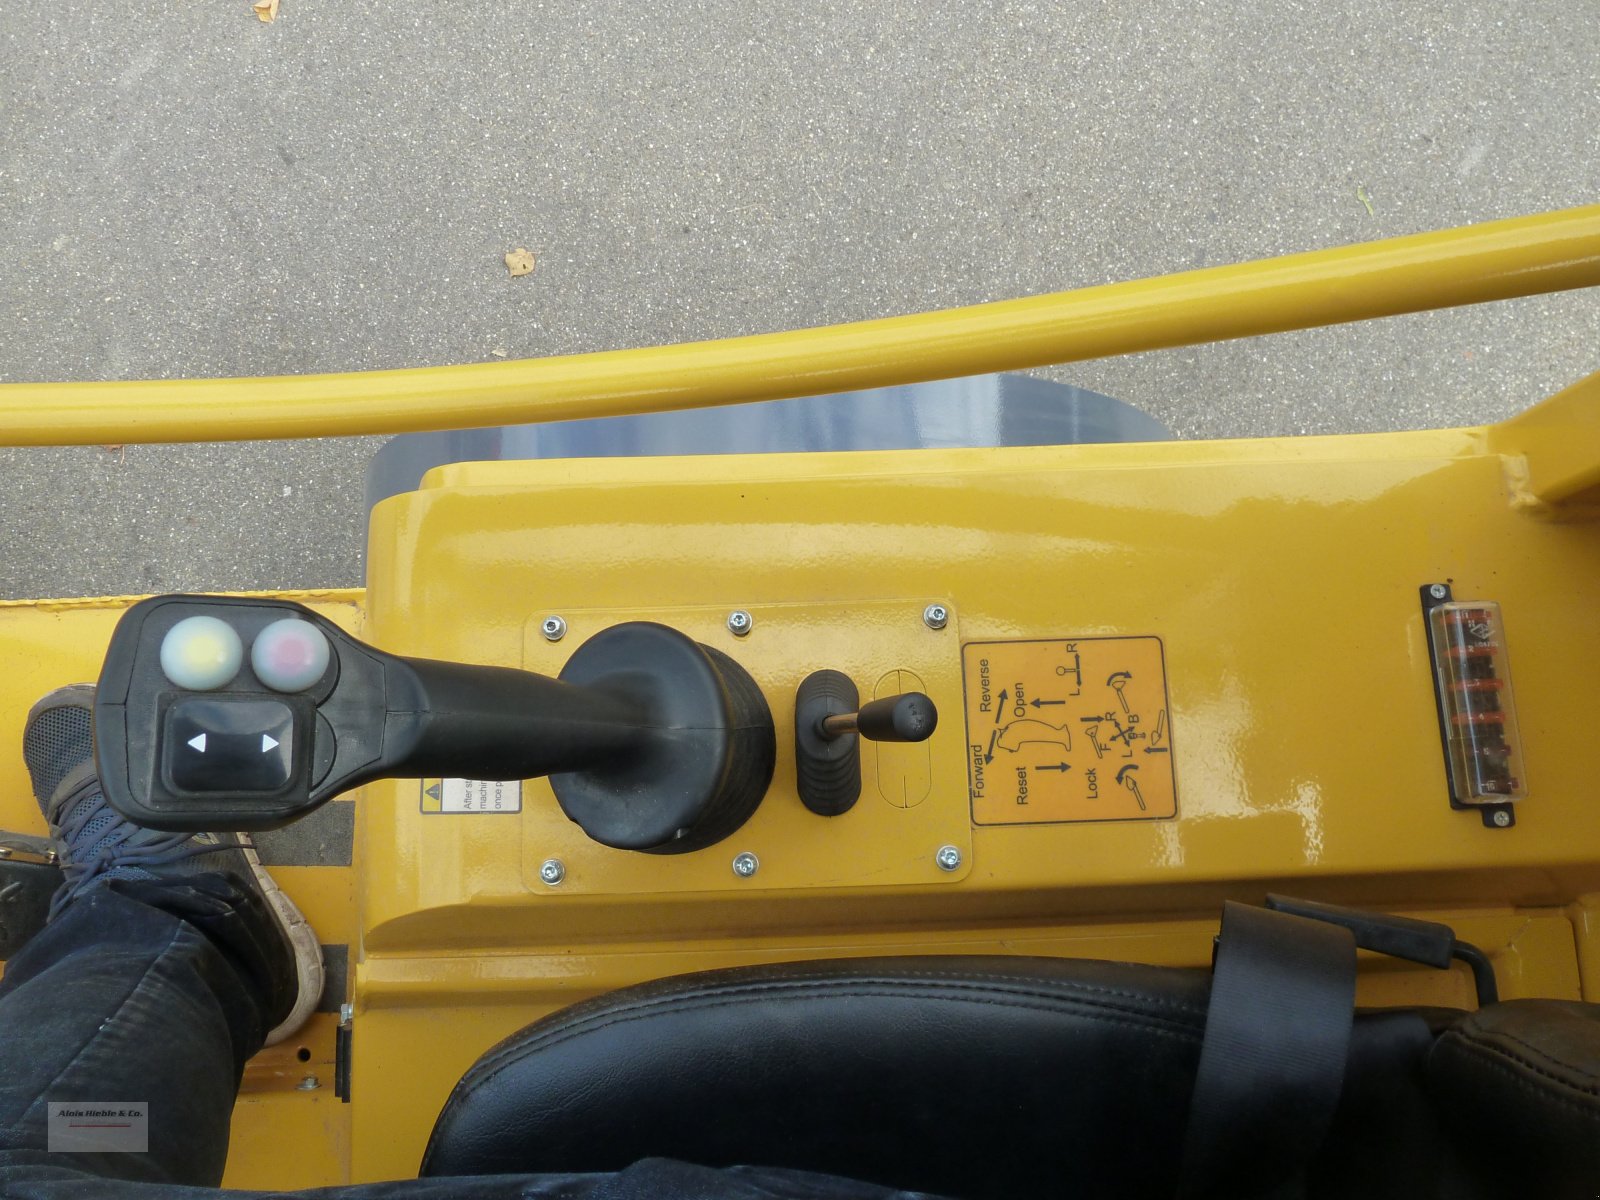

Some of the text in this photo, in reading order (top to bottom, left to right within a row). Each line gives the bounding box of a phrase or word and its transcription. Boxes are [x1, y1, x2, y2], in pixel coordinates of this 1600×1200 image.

[1067, 643, 1078, 653] R
[980, 658, 991, 712] Reverse
[1014, 682, 1028, 718] Open
[972, 744, 985, 798] Forward
[1017, 766, 1028, 805] Reset
[1087, 767, 1098, 799] Lock
[464, 789, 473, 809] After
